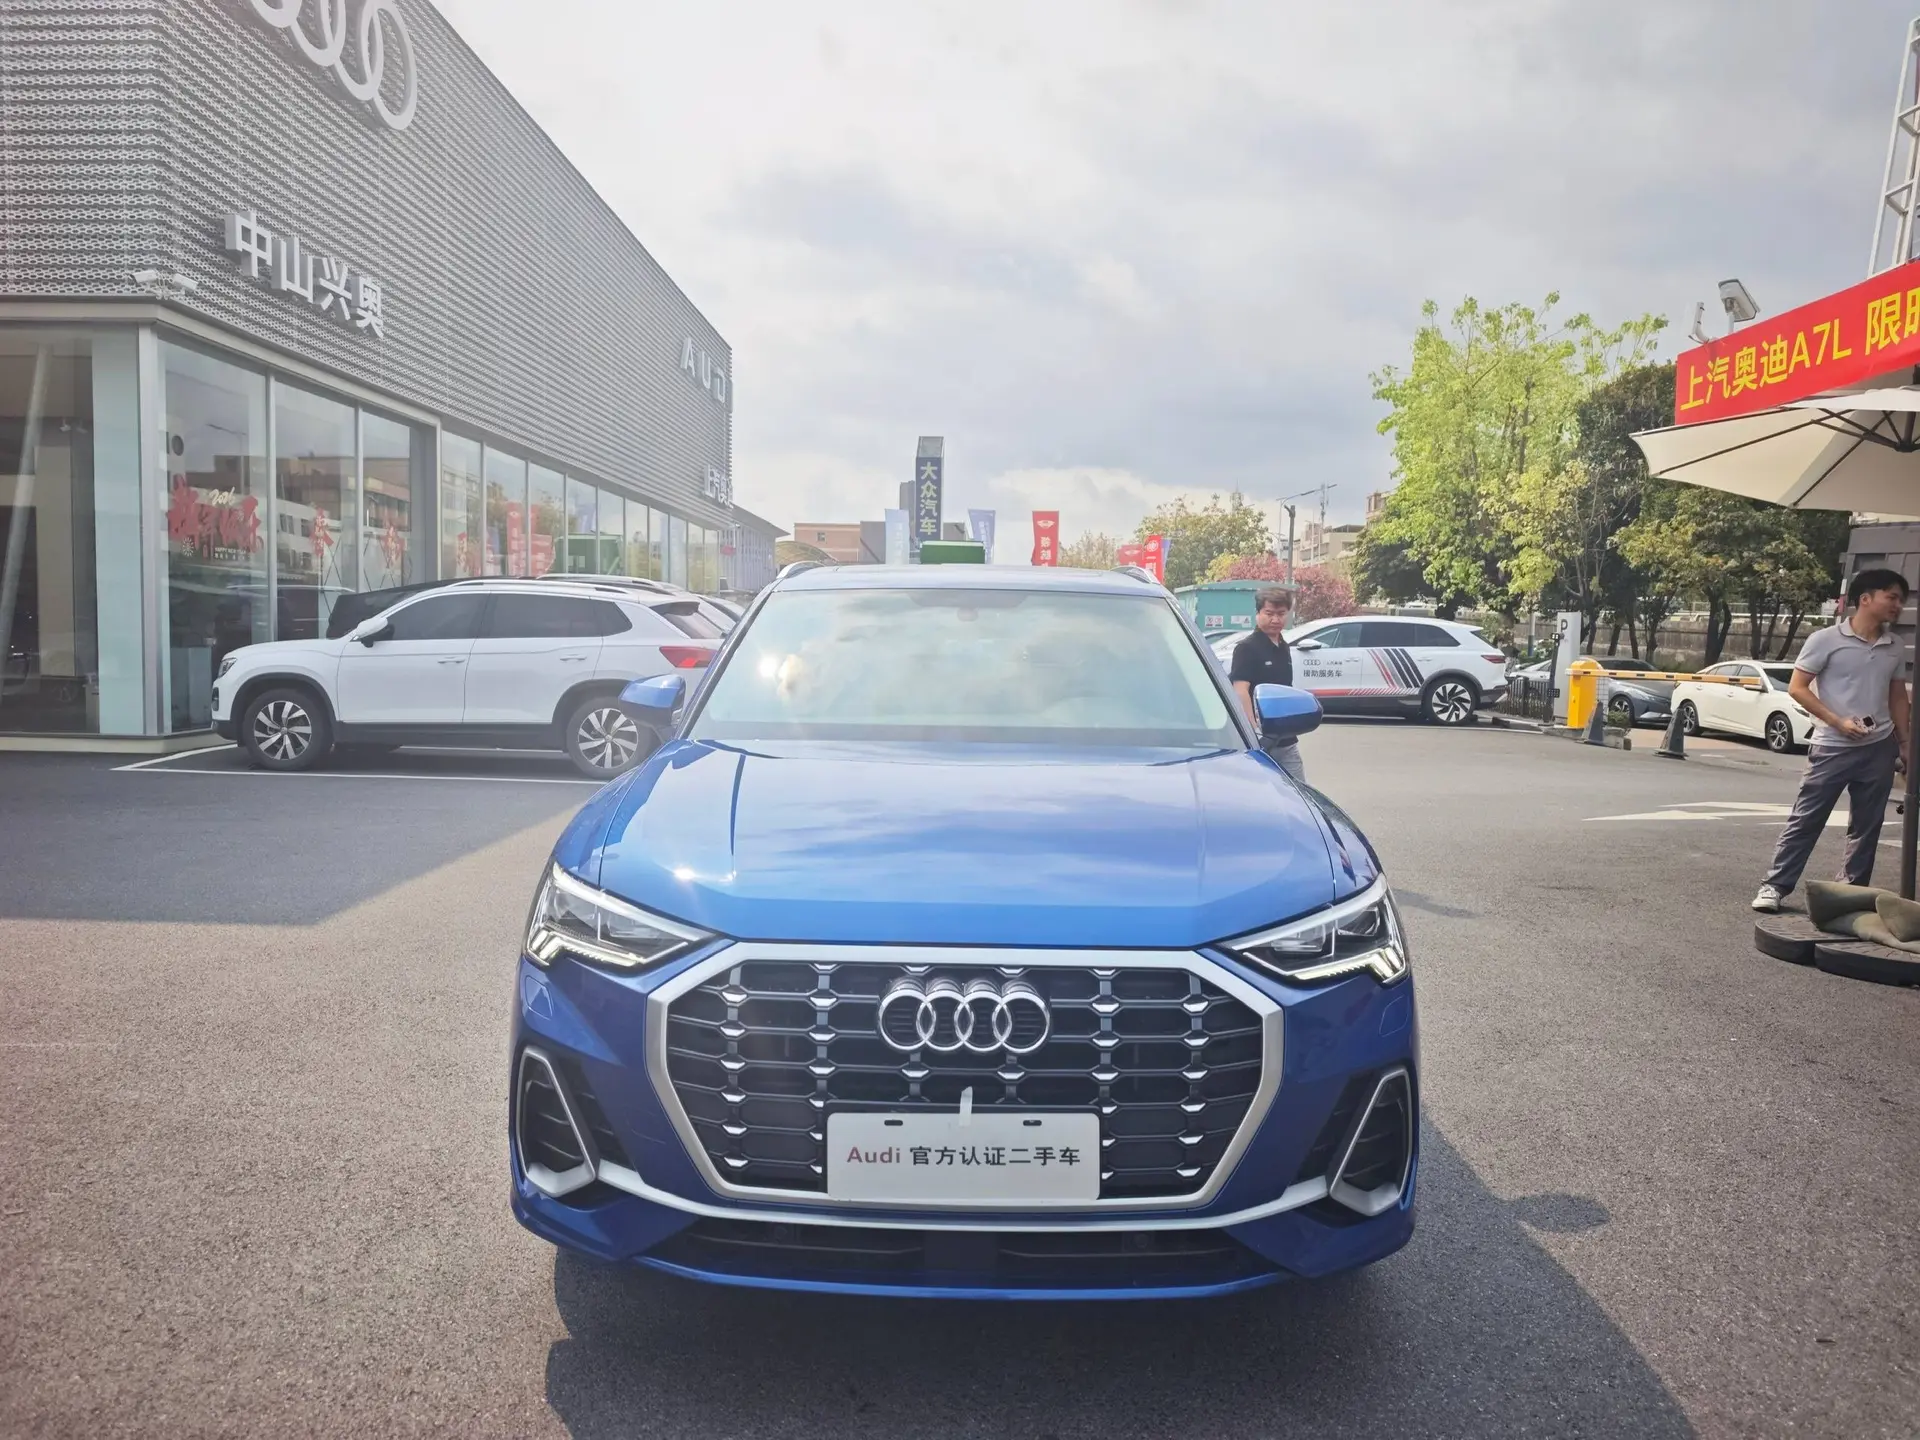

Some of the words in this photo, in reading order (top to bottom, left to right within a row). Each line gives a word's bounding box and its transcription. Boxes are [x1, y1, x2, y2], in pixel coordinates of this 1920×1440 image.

[224, 210, 383, 339] 中山兴奥
[1680, 318, 1852, 411] 上汽奥迪A7L
[920, 461, 938, 535] 大众汽车
[1560, 619, 1568, 633] P
[846, 1146, 901, 1164] Audi
[909, 1146, 1081, 1166] 官方认证二手车
